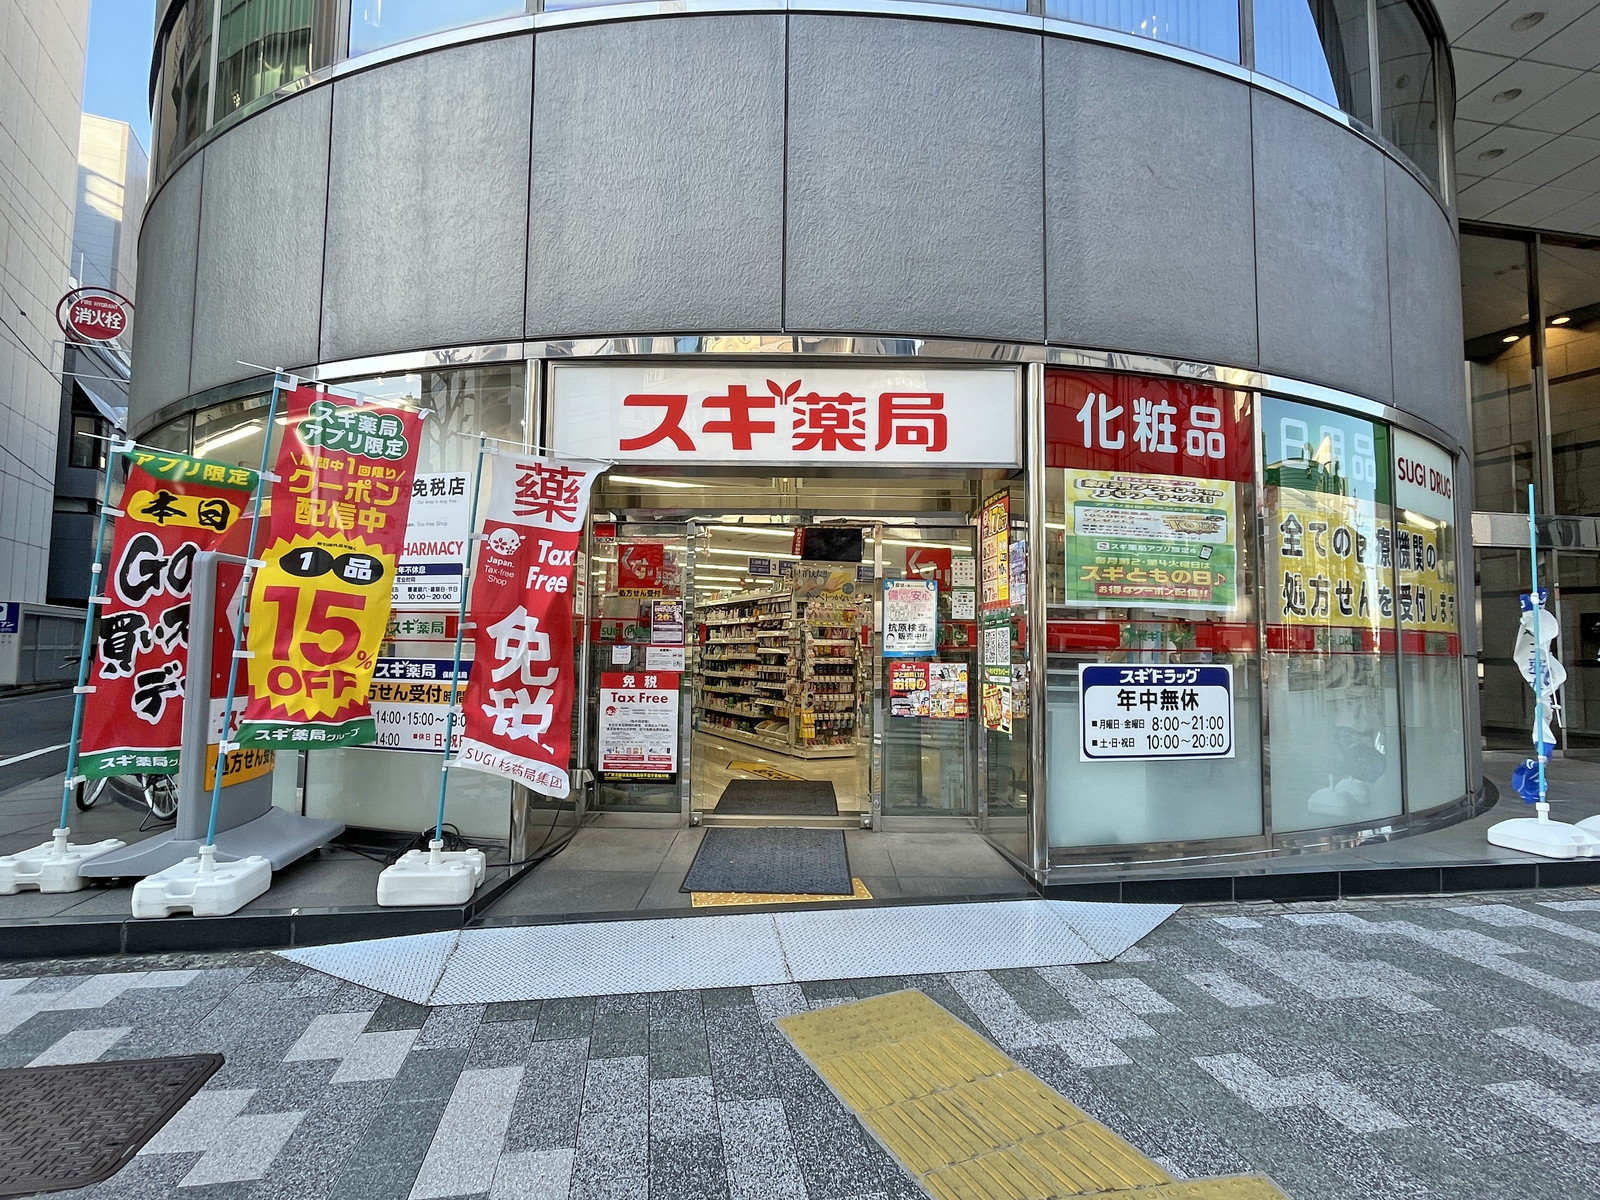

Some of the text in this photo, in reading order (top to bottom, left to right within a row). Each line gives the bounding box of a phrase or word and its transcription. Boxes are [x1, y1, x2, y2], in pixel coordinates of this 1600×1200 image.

[74, 306, 123, 330] 消火栓
[317, 406, 398, 438] スギ薬局
[619, 379, 948, 452] スギ薬局
[1076, 392, 1226, 459] 化粧品
[304, 424, 404, 457] アプリ限定
[1280, 417, 1375, 484] 日用品
[134, 453, 249, 486] アプリ限定
[1397, 457, 1452, 500] SUGI DRUG
[288, 468, 400, 507] クーポン
[411, 477, 466, 497] 免税店
[295, 496, 387, 534] 配信中
[402, 541, 464, 556] HARMACY
[537, 539, 576, 566] Tax
[397, 566, 426, 574] 年不休息
[484, 564, 515, 578] Tax-free
[486, 556, 515, 568] Japan.
[487, 574, 508, 586] Shop
[525, 566, 569, 593] Free
[619, 589, 661, 598] 処方せん受付
[389, 619, 444, 635] スギ薬局
[375, 661, 436, 678] スギ薬局
[481, 605, 560, 755] 免税
[1120, 668, 1200, 684] スギドラッグ
[267, 665, 357, 699] OFF
[622, 675, 659, 689] 免税
[611, 692, 669, 704] Tax Free
[1117, 688, 1199, 711] 年中無休
[254, 726, 361, 742] スギ薬局グループ
[1151, 716, 1224, 731] 8:00～21:00
[1147, 733, 1224, 750] 10:00～20:00
[465, 748, 564, 789] SUGI 杉药局集团
